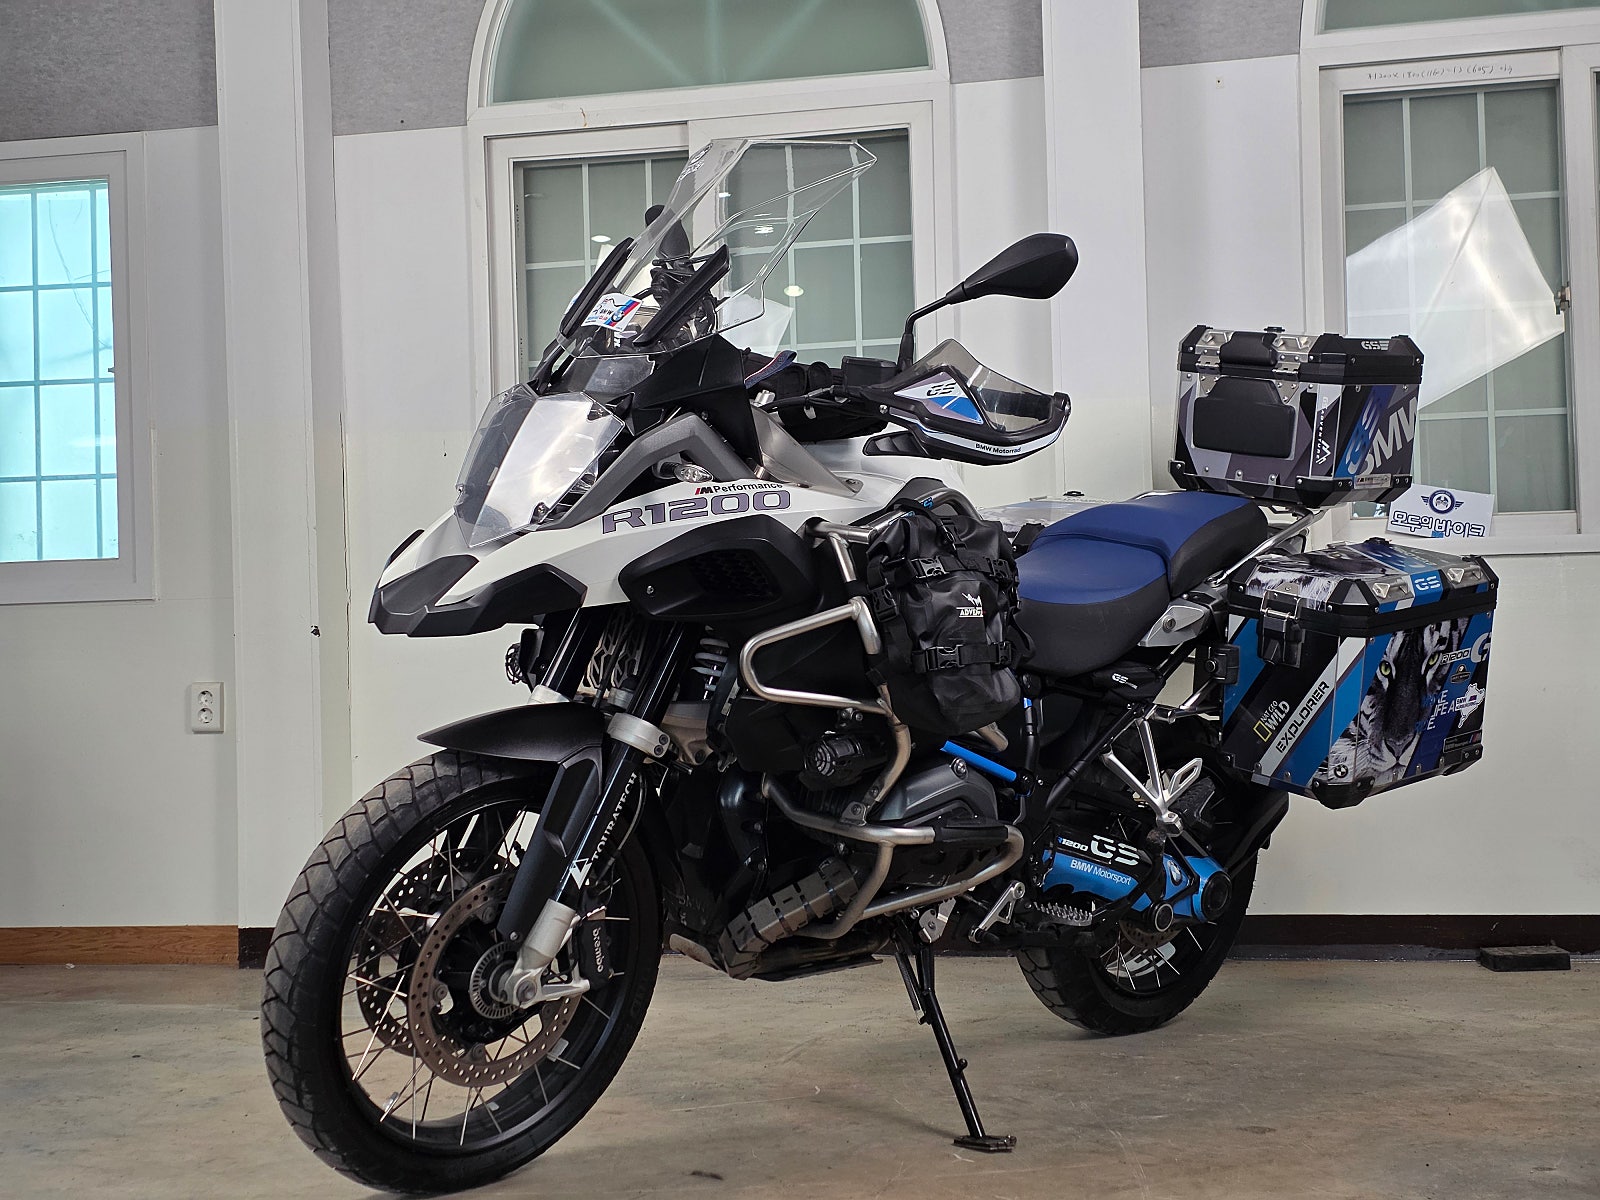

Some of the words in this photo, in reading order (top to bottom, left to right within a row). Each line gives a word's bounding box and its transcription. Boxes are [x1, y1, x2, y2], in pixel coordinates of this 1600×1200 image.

[926, 382, 957, 397] GS
[976, 443, 992, 452] BMW
[602, 490, 791, 534] R1200
[1414, 576, 1441, 591] GS
[1112, 673, 1129, 684] GS
[1265, 700, 1290, 731] WILD
[1276, 681, 1330, 753] EXPLORER
[592, 772, 637, 861] TOURATECH
[1057, 836, 1089, 852] R1200
[1091, 834, 1140, 866] GS
[1070, 859, 1093, 873] BMW
[1093, 867, 1132, 886] Motorsport
[592, 926, 604, 973] brembo
